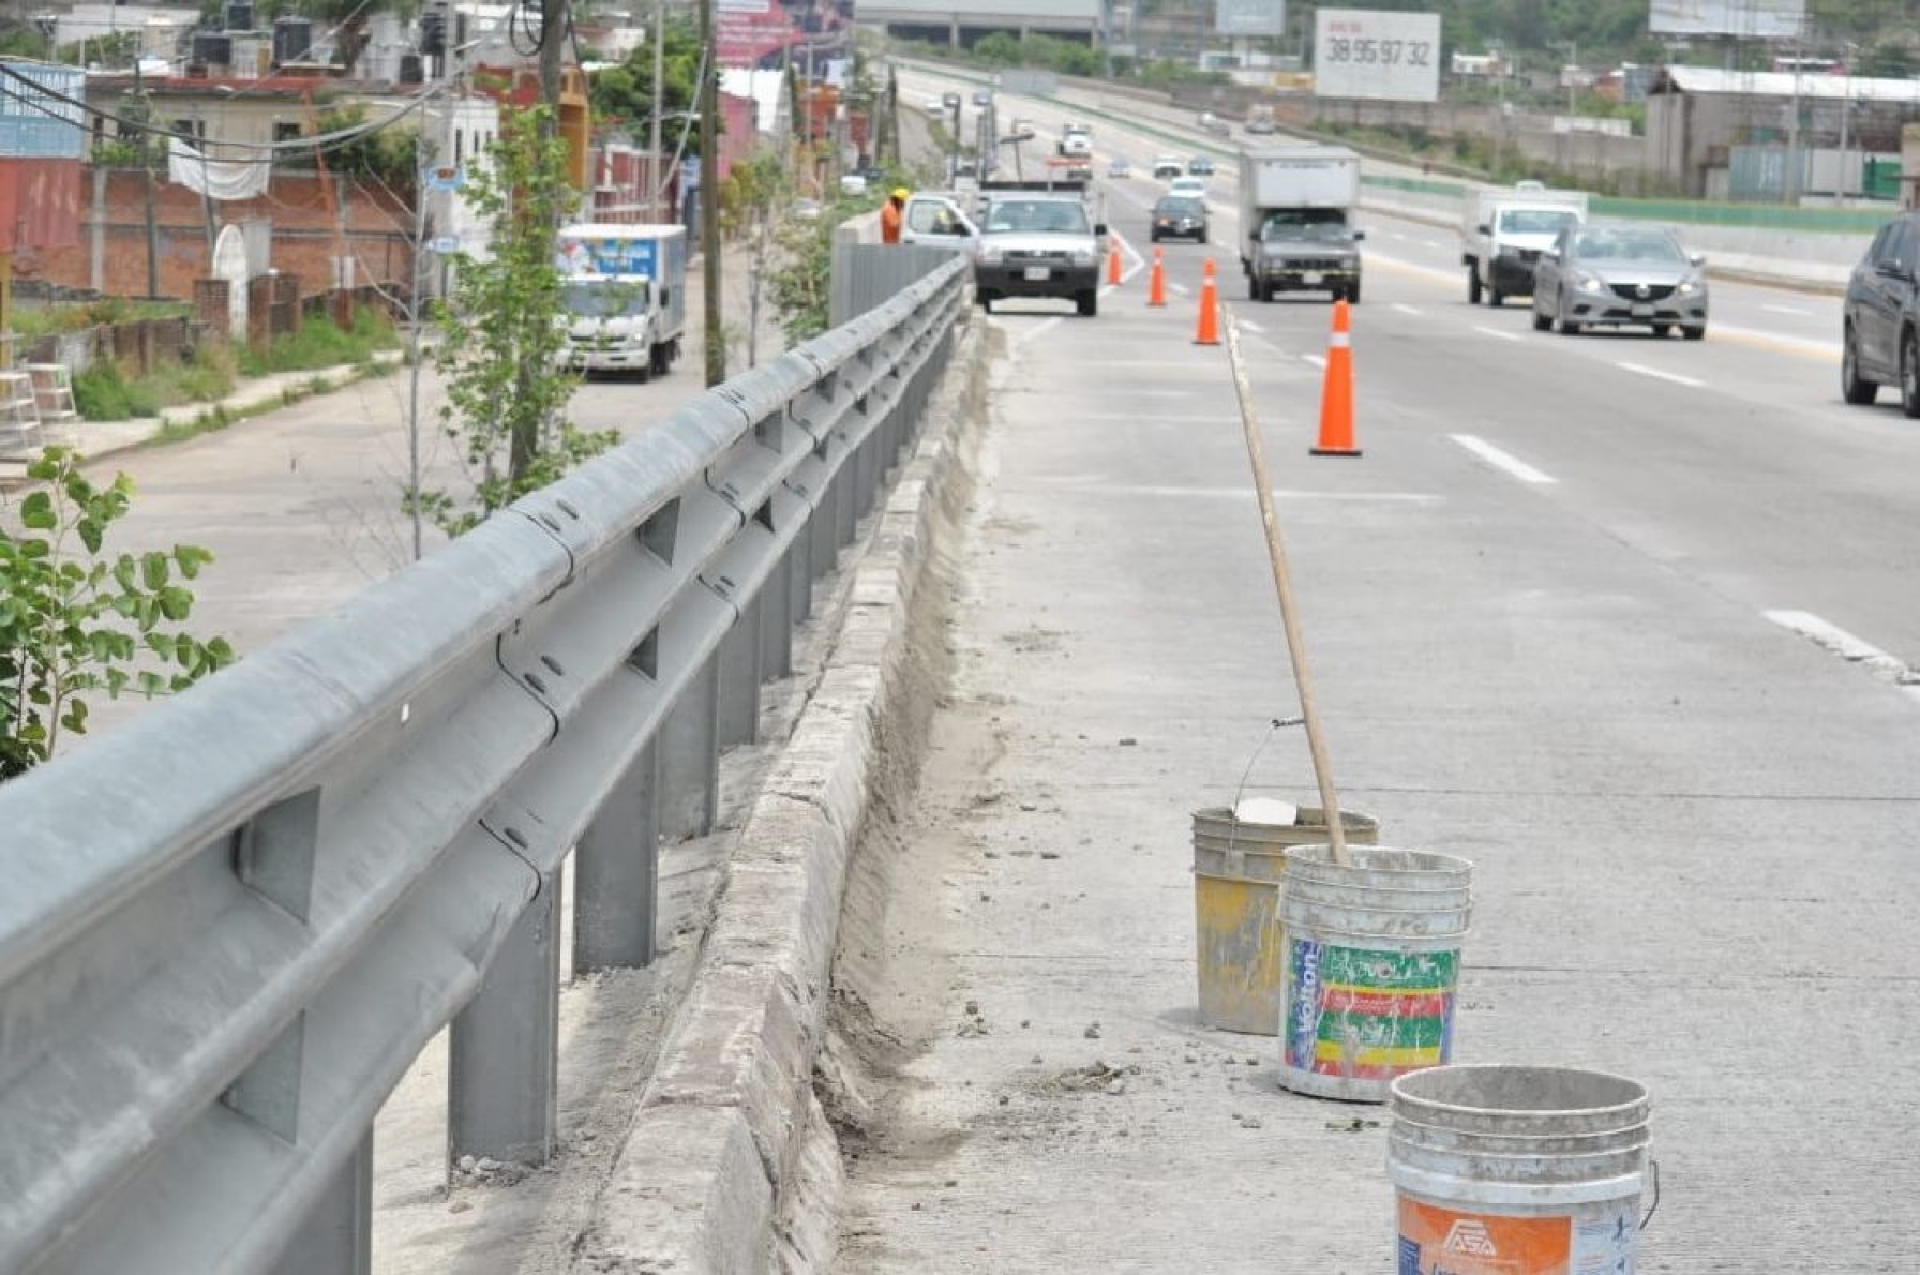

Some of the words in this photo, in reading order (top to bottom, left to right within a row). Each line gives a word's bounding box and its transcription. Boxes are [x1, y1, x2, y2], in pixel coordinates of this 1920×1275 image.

[1326, 39, 1350, 61] 38
[1353, 39, 1378, 64] 95
[1380, 40, 1403, 64] 97
[1408, 42, 1430, 66] 32
[1446, 1227, 1497, 1257] ASA
